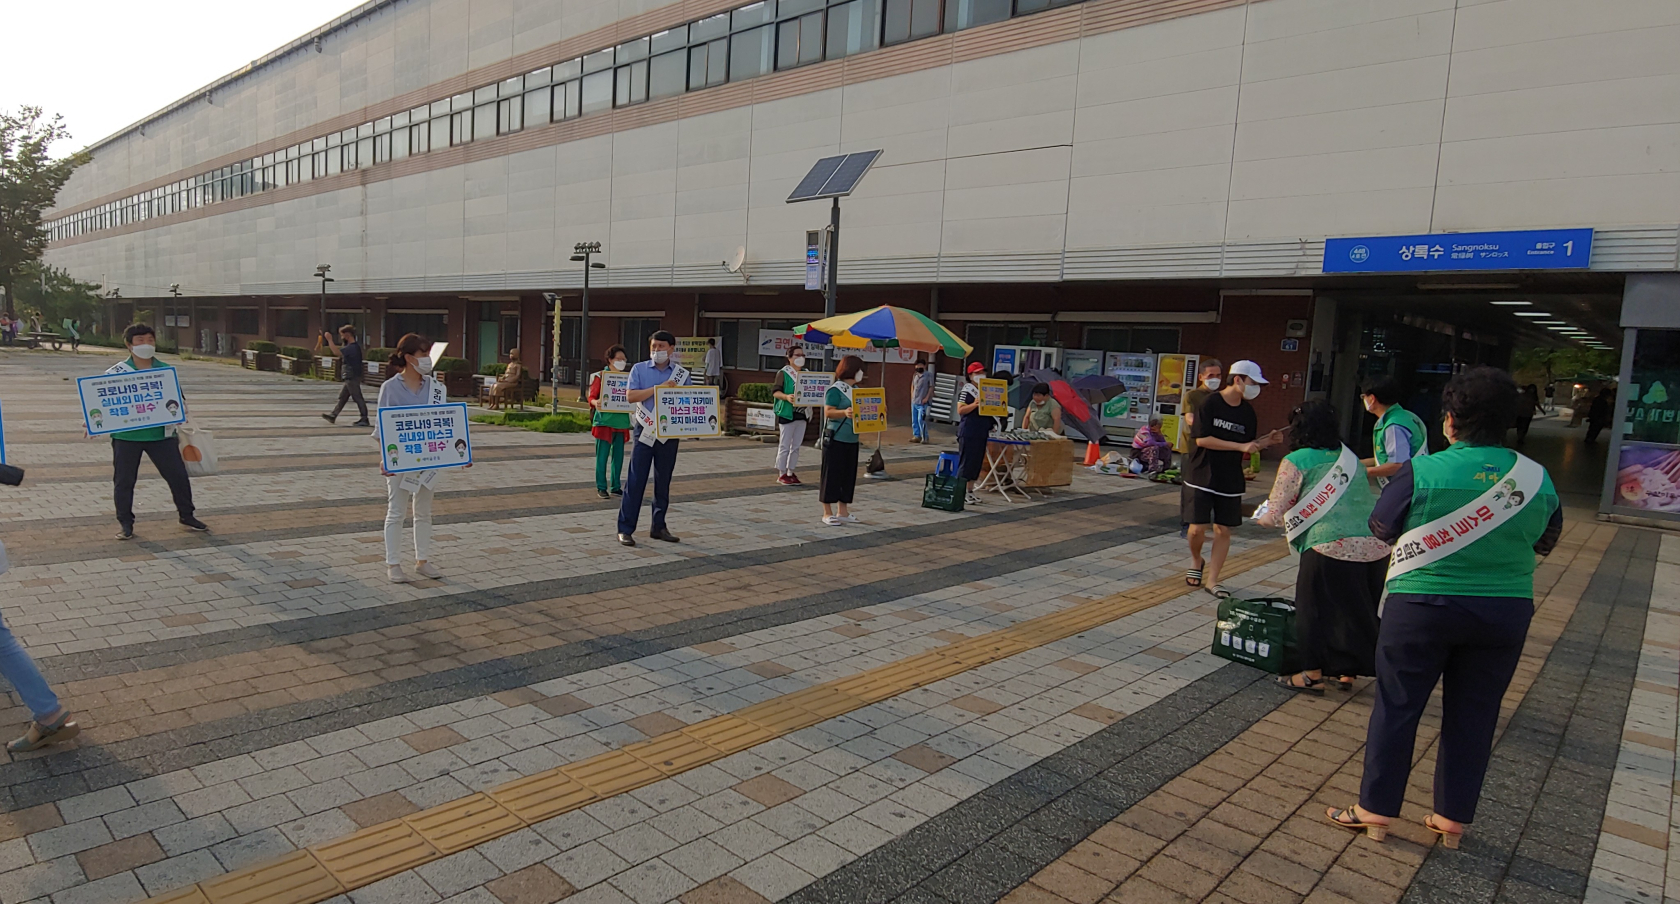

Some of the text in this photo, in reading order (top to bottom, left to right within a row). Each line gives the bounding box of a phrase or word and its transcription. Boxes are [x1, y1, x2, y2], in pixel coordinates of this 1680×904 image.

[1398, 244, 1445, 261] 상록수
[1452, 243, 1499, 252] Sangnoksu
[1562, 240, 1574, 256] 1
[97, 381, 163, 397] 코로나19 극복!
[101, 391, 163, 407] 실내외 마스크
[662, 397, 674, 405] 우리
[693, 397, 714, 405] 지키미!
[395, 417, 454, 431] 코로나19 극복!
[671, 416, 706, 425] 잊지 마세요!
[398, 429, 453, 442] 실내외 마스크
[1312, 483, 1337, 507] 마스크
[1450, 505, 1495, 537] 마스크
[1422, 528, 1454, 550] 착용
